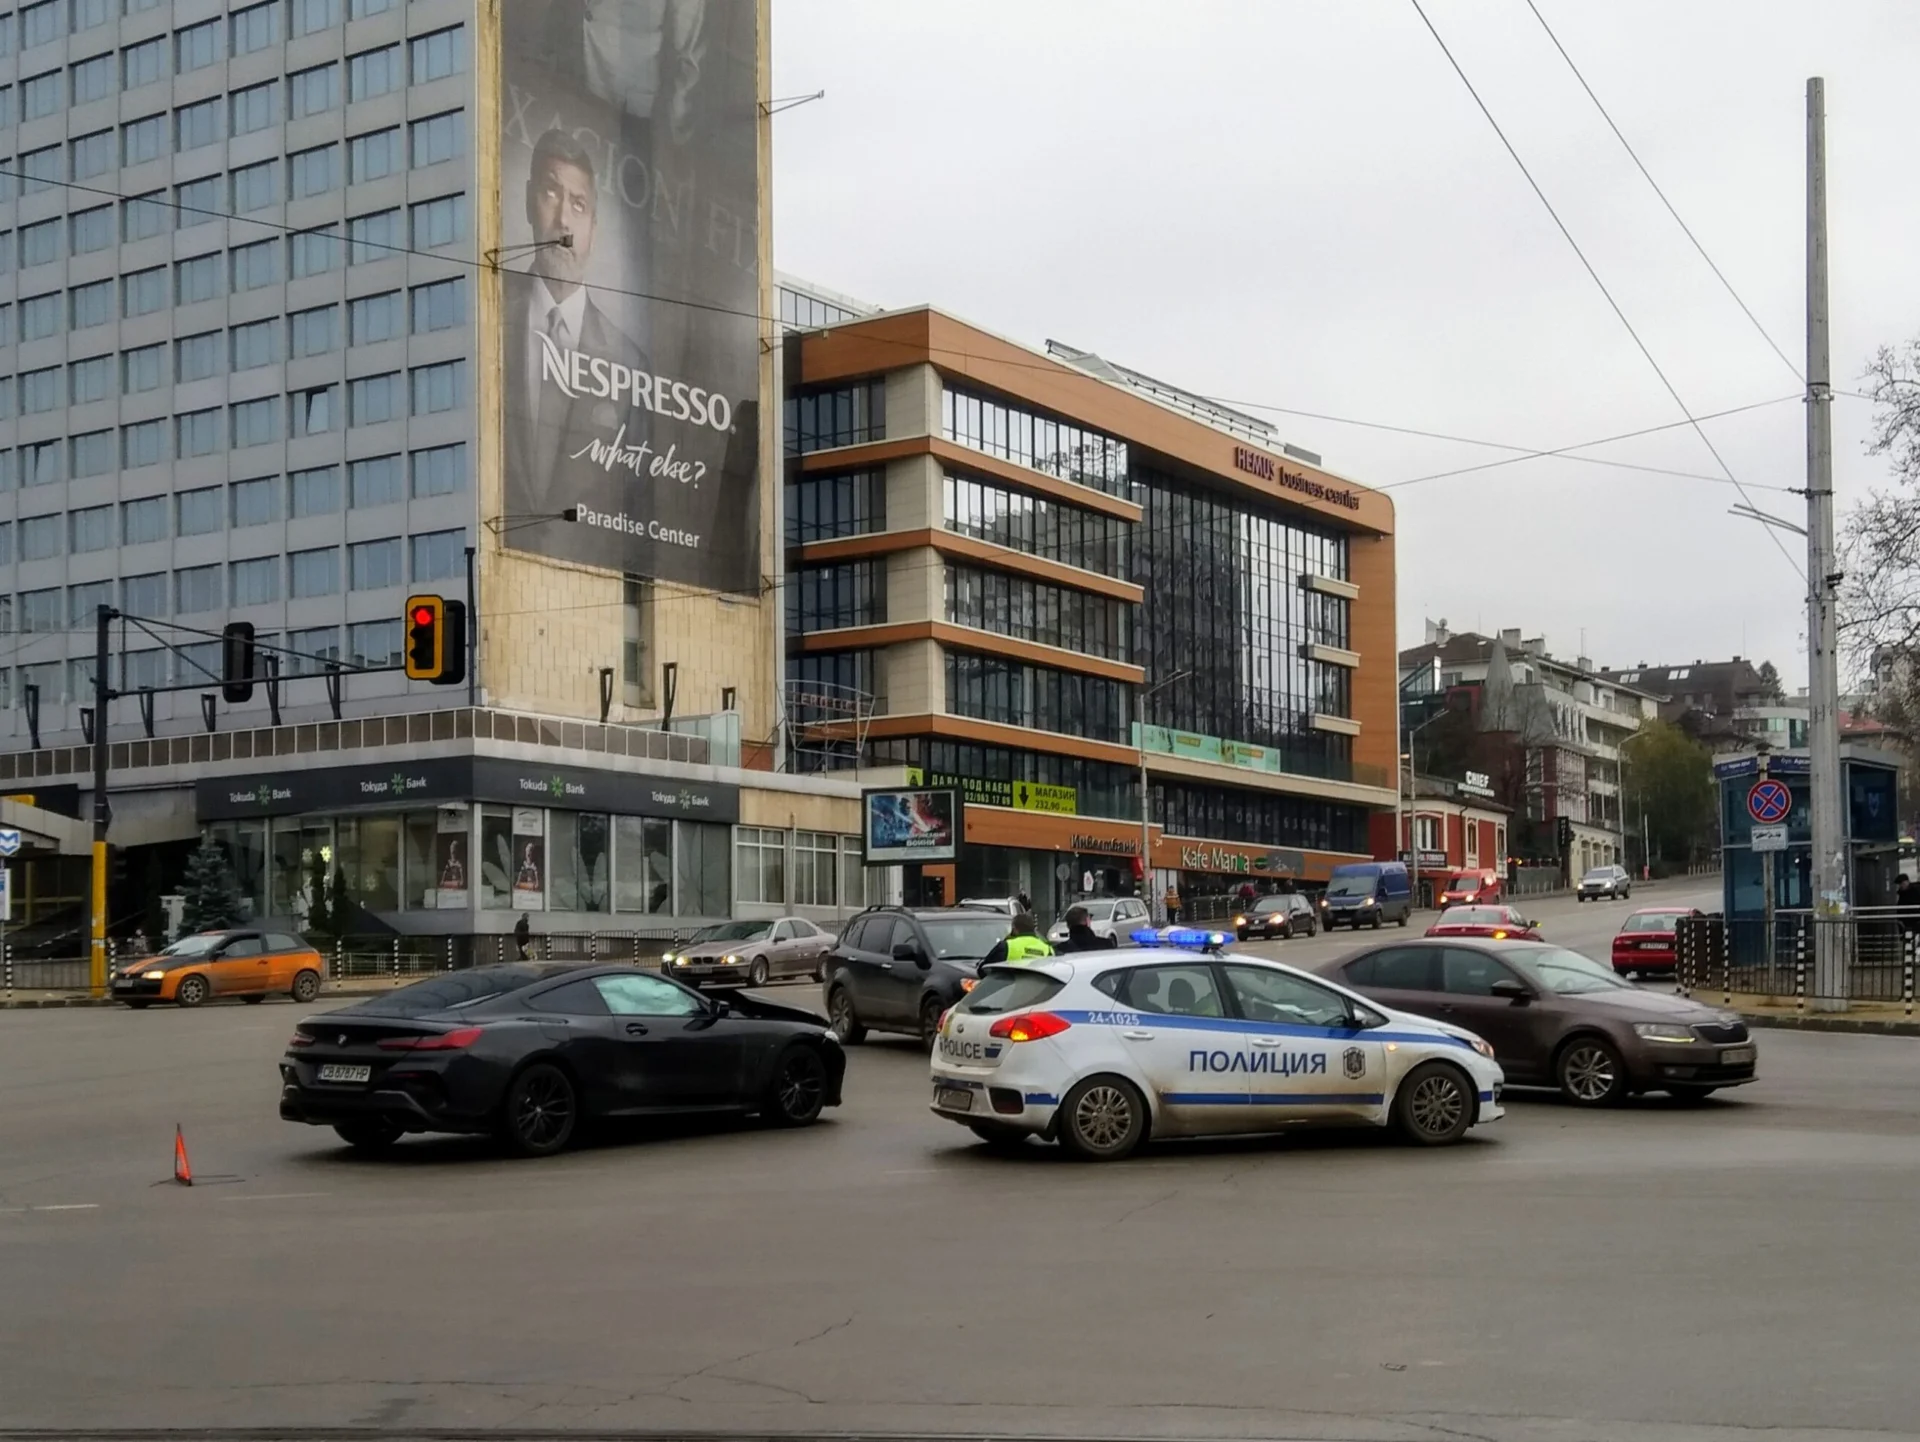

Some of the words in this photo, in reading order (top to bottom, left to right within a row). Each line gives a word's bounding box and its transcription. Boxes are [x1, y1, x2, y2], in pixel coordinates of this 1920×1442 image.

[534, 330, 731, 431] NESPRESSO
[569, 423, 653, 477] what
[650, 443, 706, 489] else?
[1234, 446, 1274, 481] HEMUS
[577, 503, 644, 536] Paradise
[649, 521, 700, 548] Center
[406, 776, 427, 789] Банк
[519, 778, 548, 792] Tokuda
[565, 783, 585, 795] Bank
[1035, 786, 1075, 801] МАГАЗИН
[1088, 1011, 1140, 1026] 24-1025
[944, 1038, 982, 1059] POLICE
[1190, 1051, 1327, 1077] ПОЛИЦИЯ
